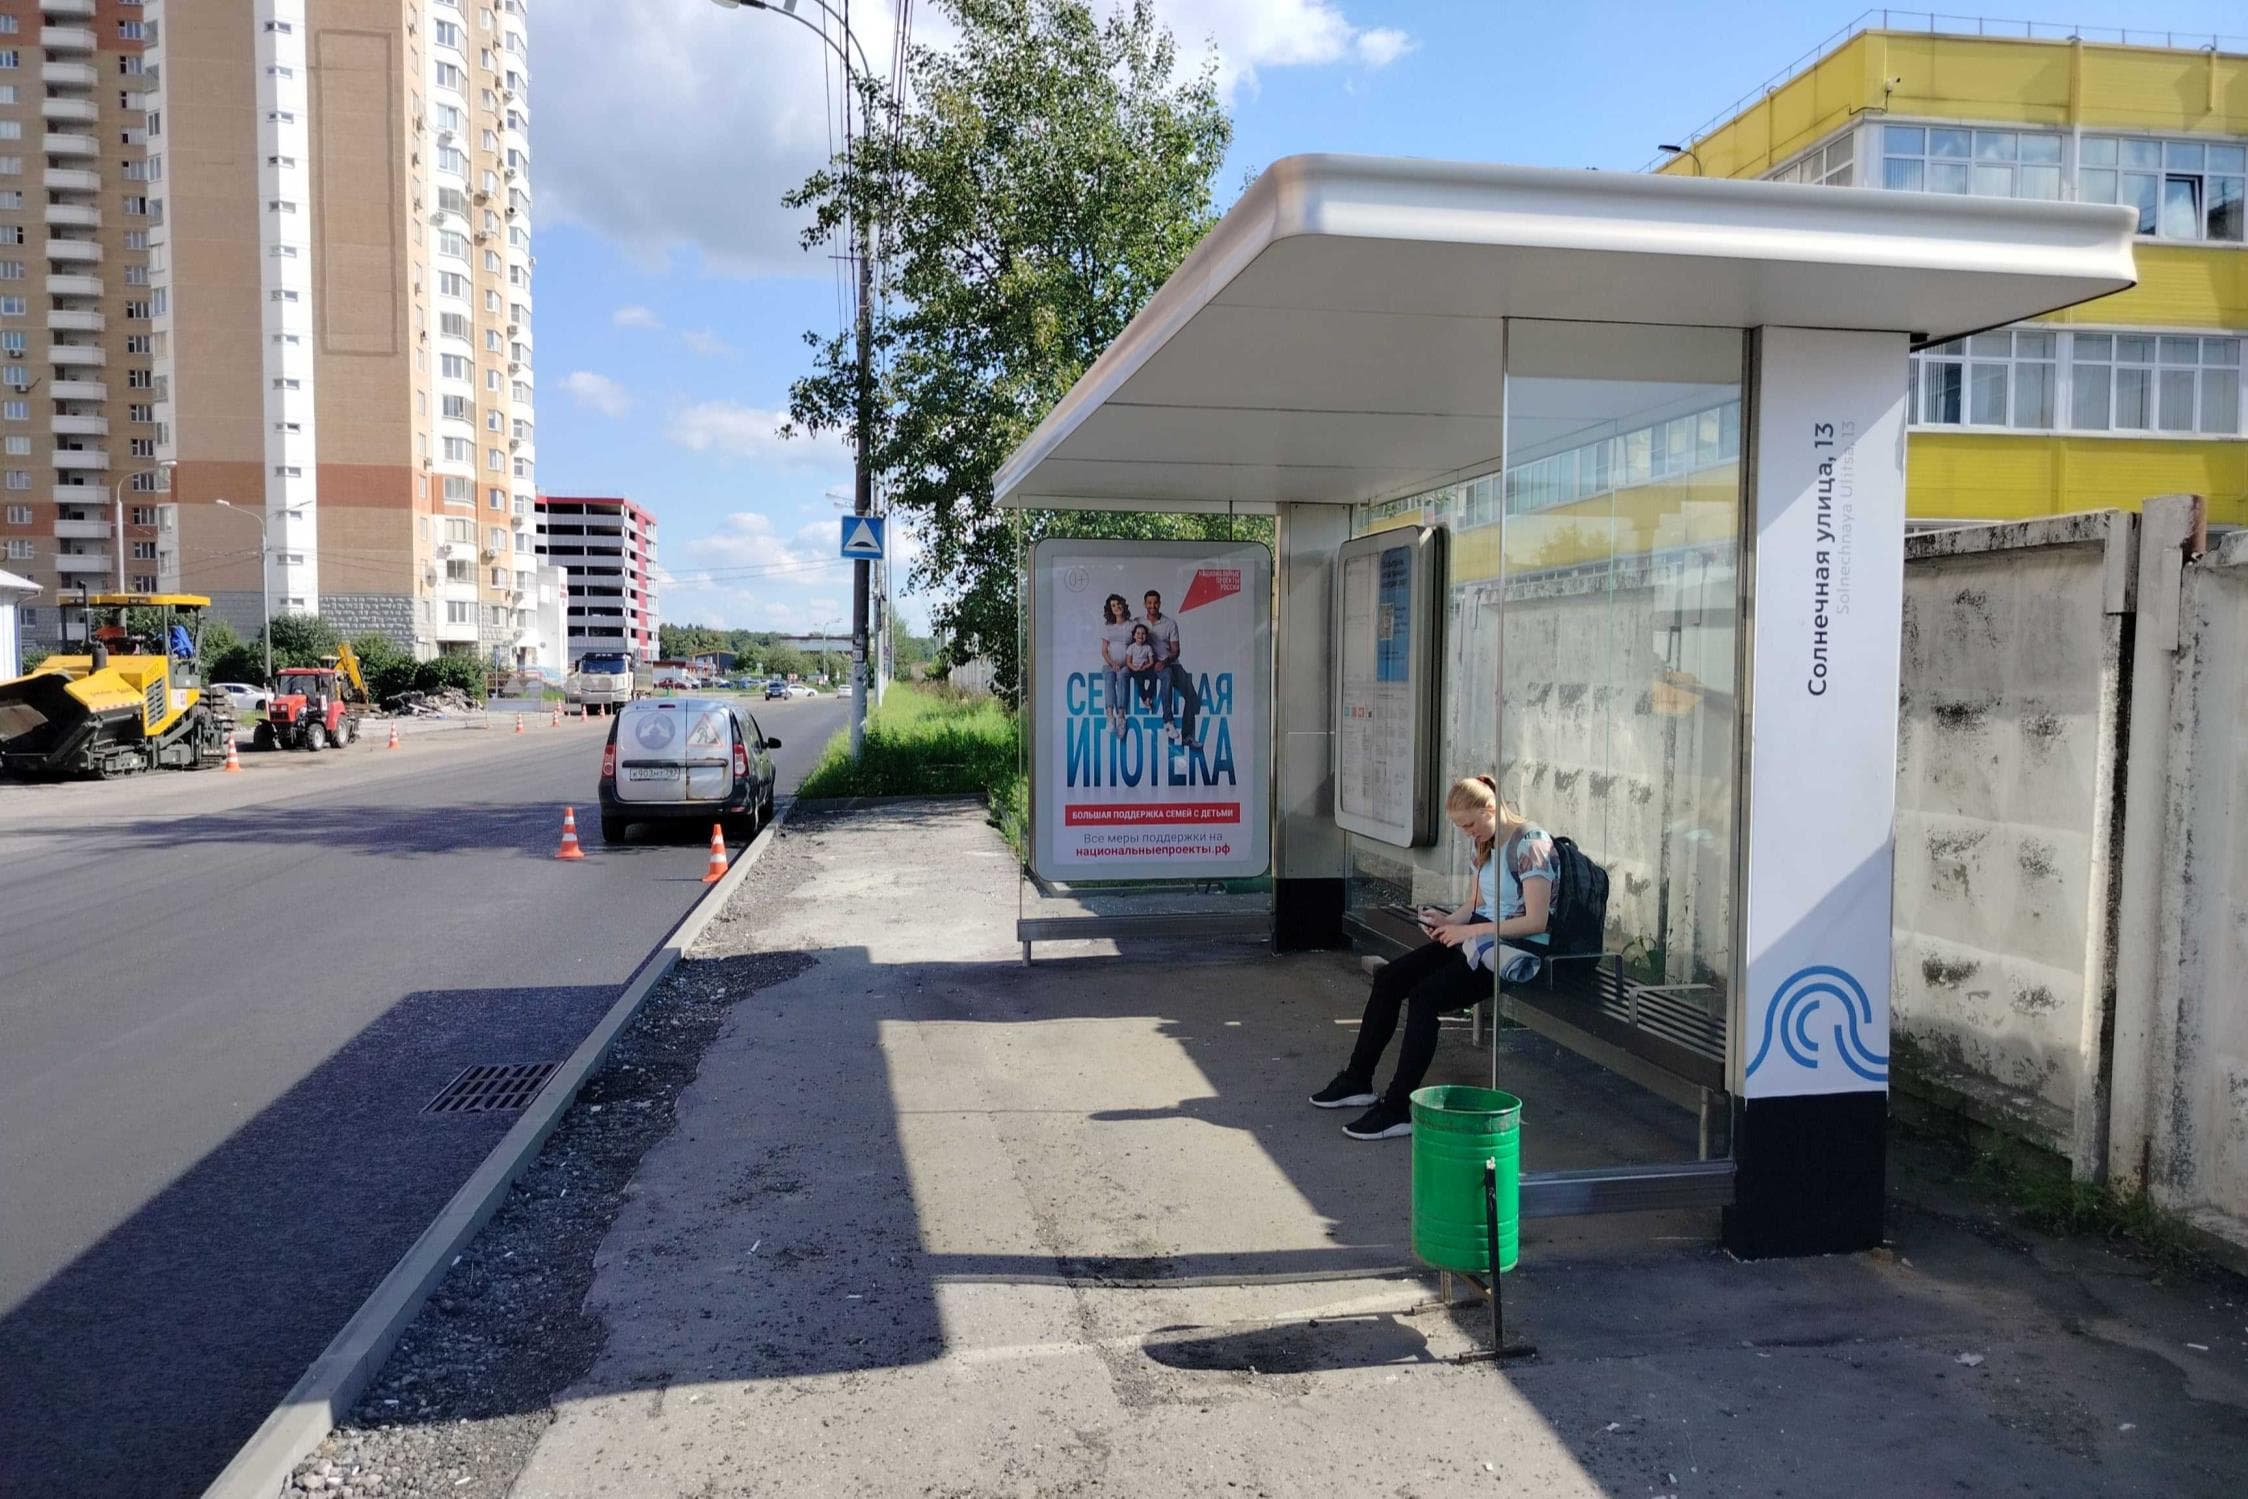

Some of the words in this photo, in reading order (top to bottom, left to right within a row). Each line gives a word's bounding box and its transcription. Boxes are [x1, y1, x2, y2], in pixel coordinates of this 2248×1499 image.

[1815, 422, 1834, 449] 13
[1817, 456, 1836, 543] улица,
[1836, 504, 1856, 615] Solnechnaya
[1808, 551, 1830, 696] Солнечная
[1066, 717, 1237, 787] ИПОТЕКА
[1072, 811, 1112, 820] БОЛЬШАЯ
[1113, 810, 1164, 820] ПОДДЕРЖКА
[1165, 809, 1193, 818] СЕМЕЙ
[1201, 809, 1233, 818] ДЕТЬМИ
[1084, 833, 1104, 844] Все
[1107, 834, 1139, 845] меры
[1142, 832, 1207, 844] поддержки
[1209, 832, 1223, 842] на
[1076, 843, 1231, 857] национальныепроекты.рф
